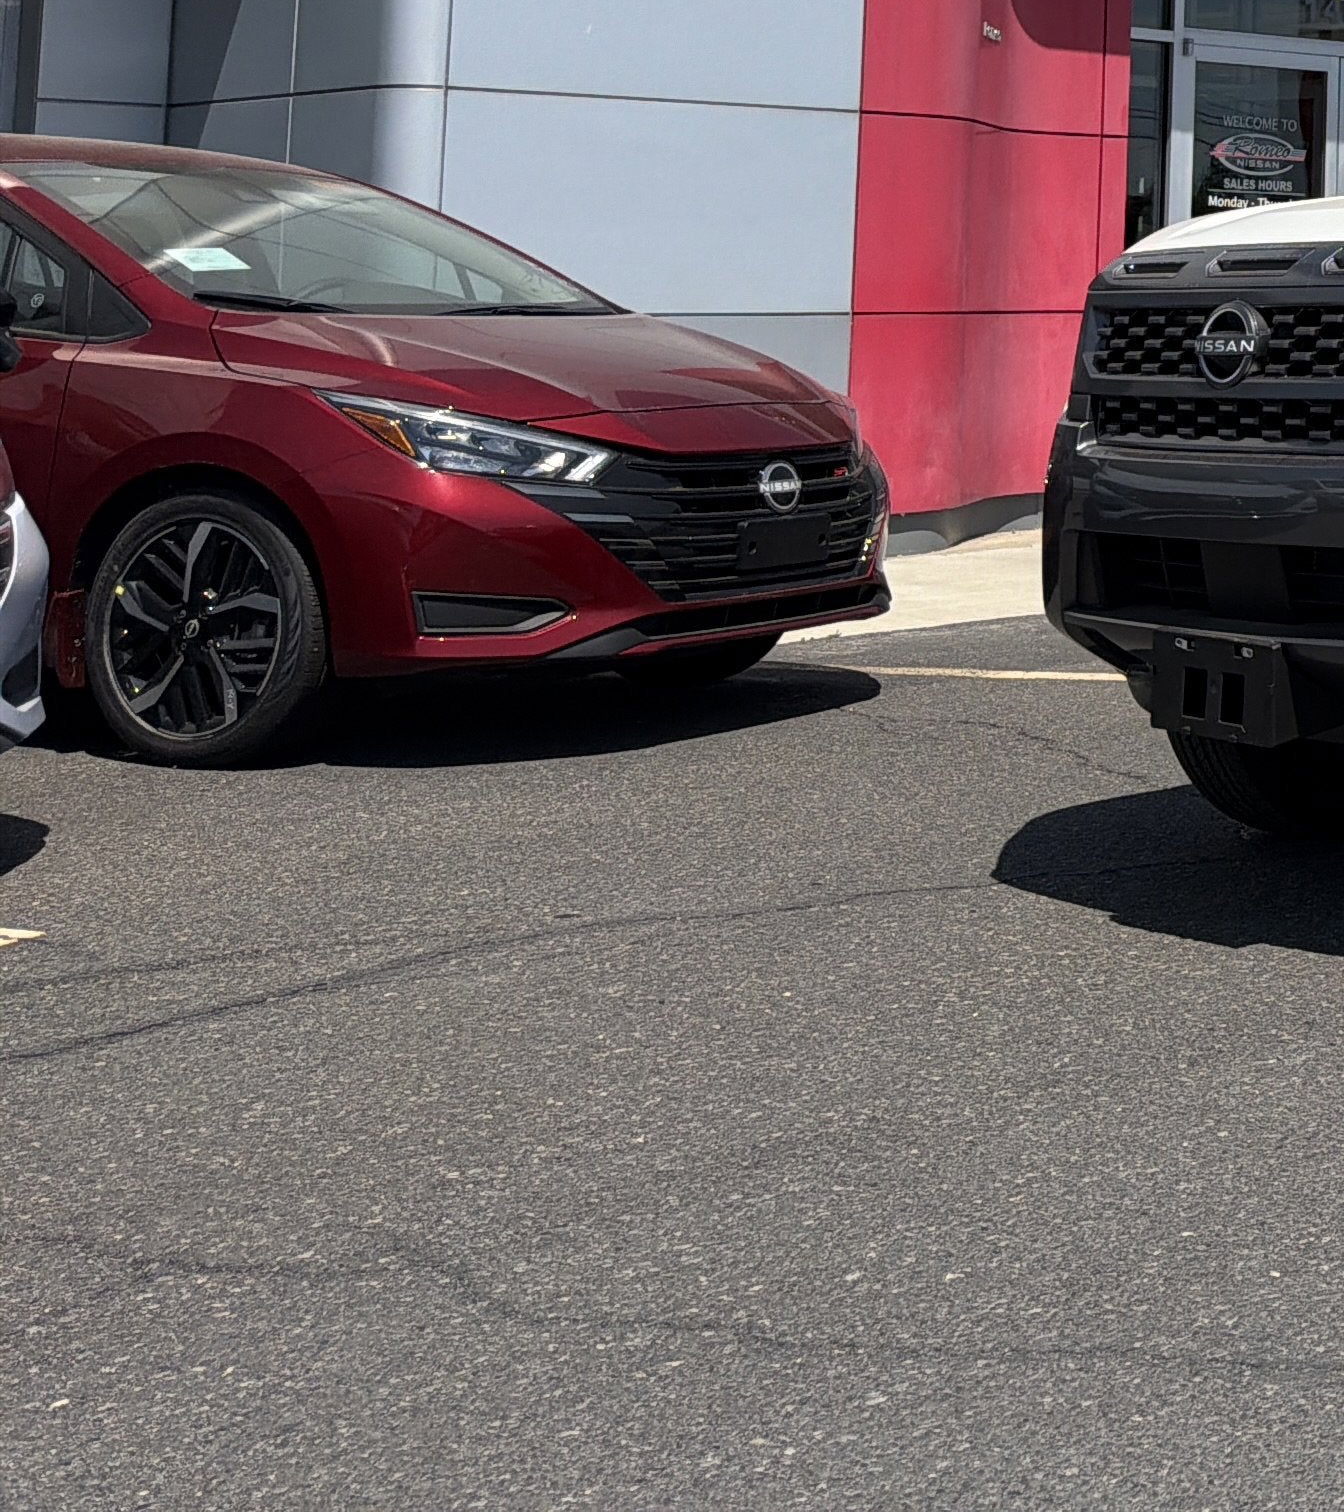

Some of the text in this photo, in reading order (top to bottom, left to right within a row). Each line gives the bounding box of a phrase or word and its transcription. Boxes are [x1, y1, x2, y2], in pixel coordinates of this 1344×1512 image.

[1222, 115, 1297, 132] WELCOME TO
[1232, 135, 1291, 158] Romeo
[1236, 158, 1280, 169] NISSAN
[1223, 177, 1293, 192] SALES HOURS
[1207, 195, 1249, 208] Monday
[1194, 339, 1255, 353] NISSAN
